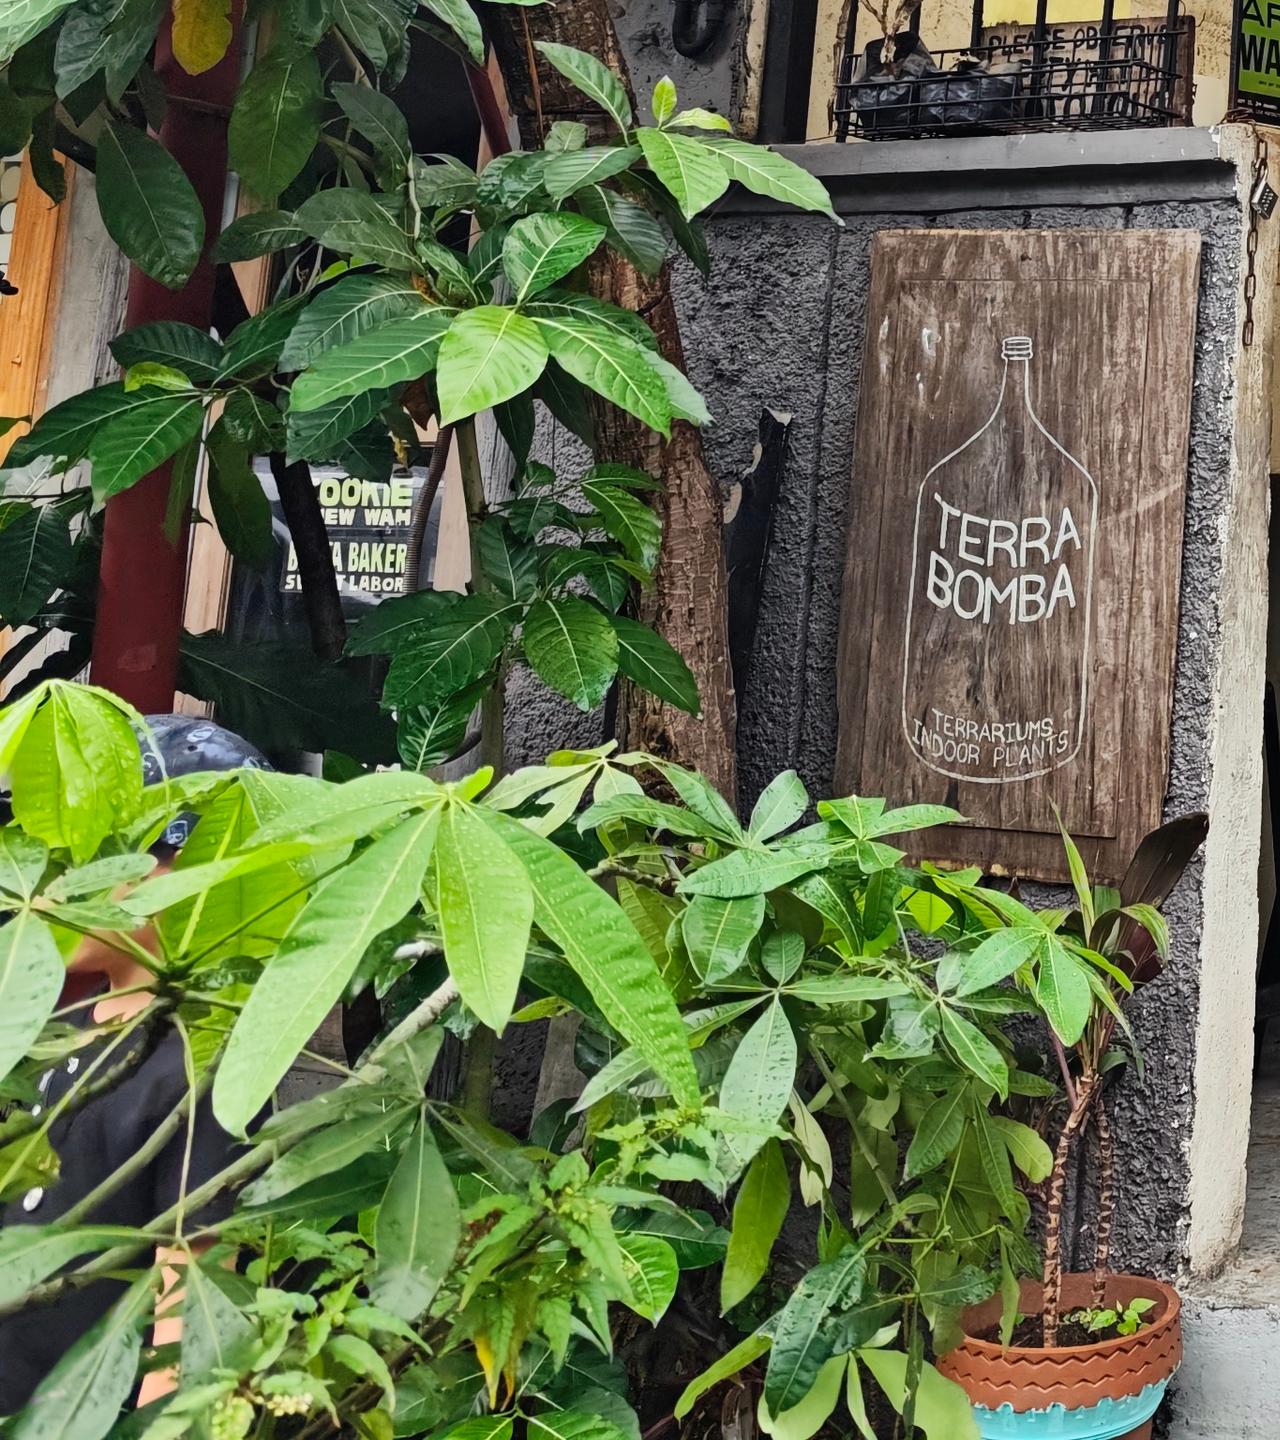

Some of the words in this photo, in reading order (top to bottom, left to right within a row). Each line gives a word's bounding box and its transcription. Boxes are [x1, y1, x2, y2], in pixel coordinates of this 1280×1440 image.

[319, 477, 413, 507] OOKIE
[934, 491, 1082, 569] TERRA
[348, 542, 408, 574] BAKER
[349, 574, 405, 593] LABOR
[926, 550, 1076, 625] BOMBA
[911, 718, 980, 766] INDOOR
[992, 728, 1069, 768] PLANTS
[932, 707, 1054, 744] TERRARIUMS
